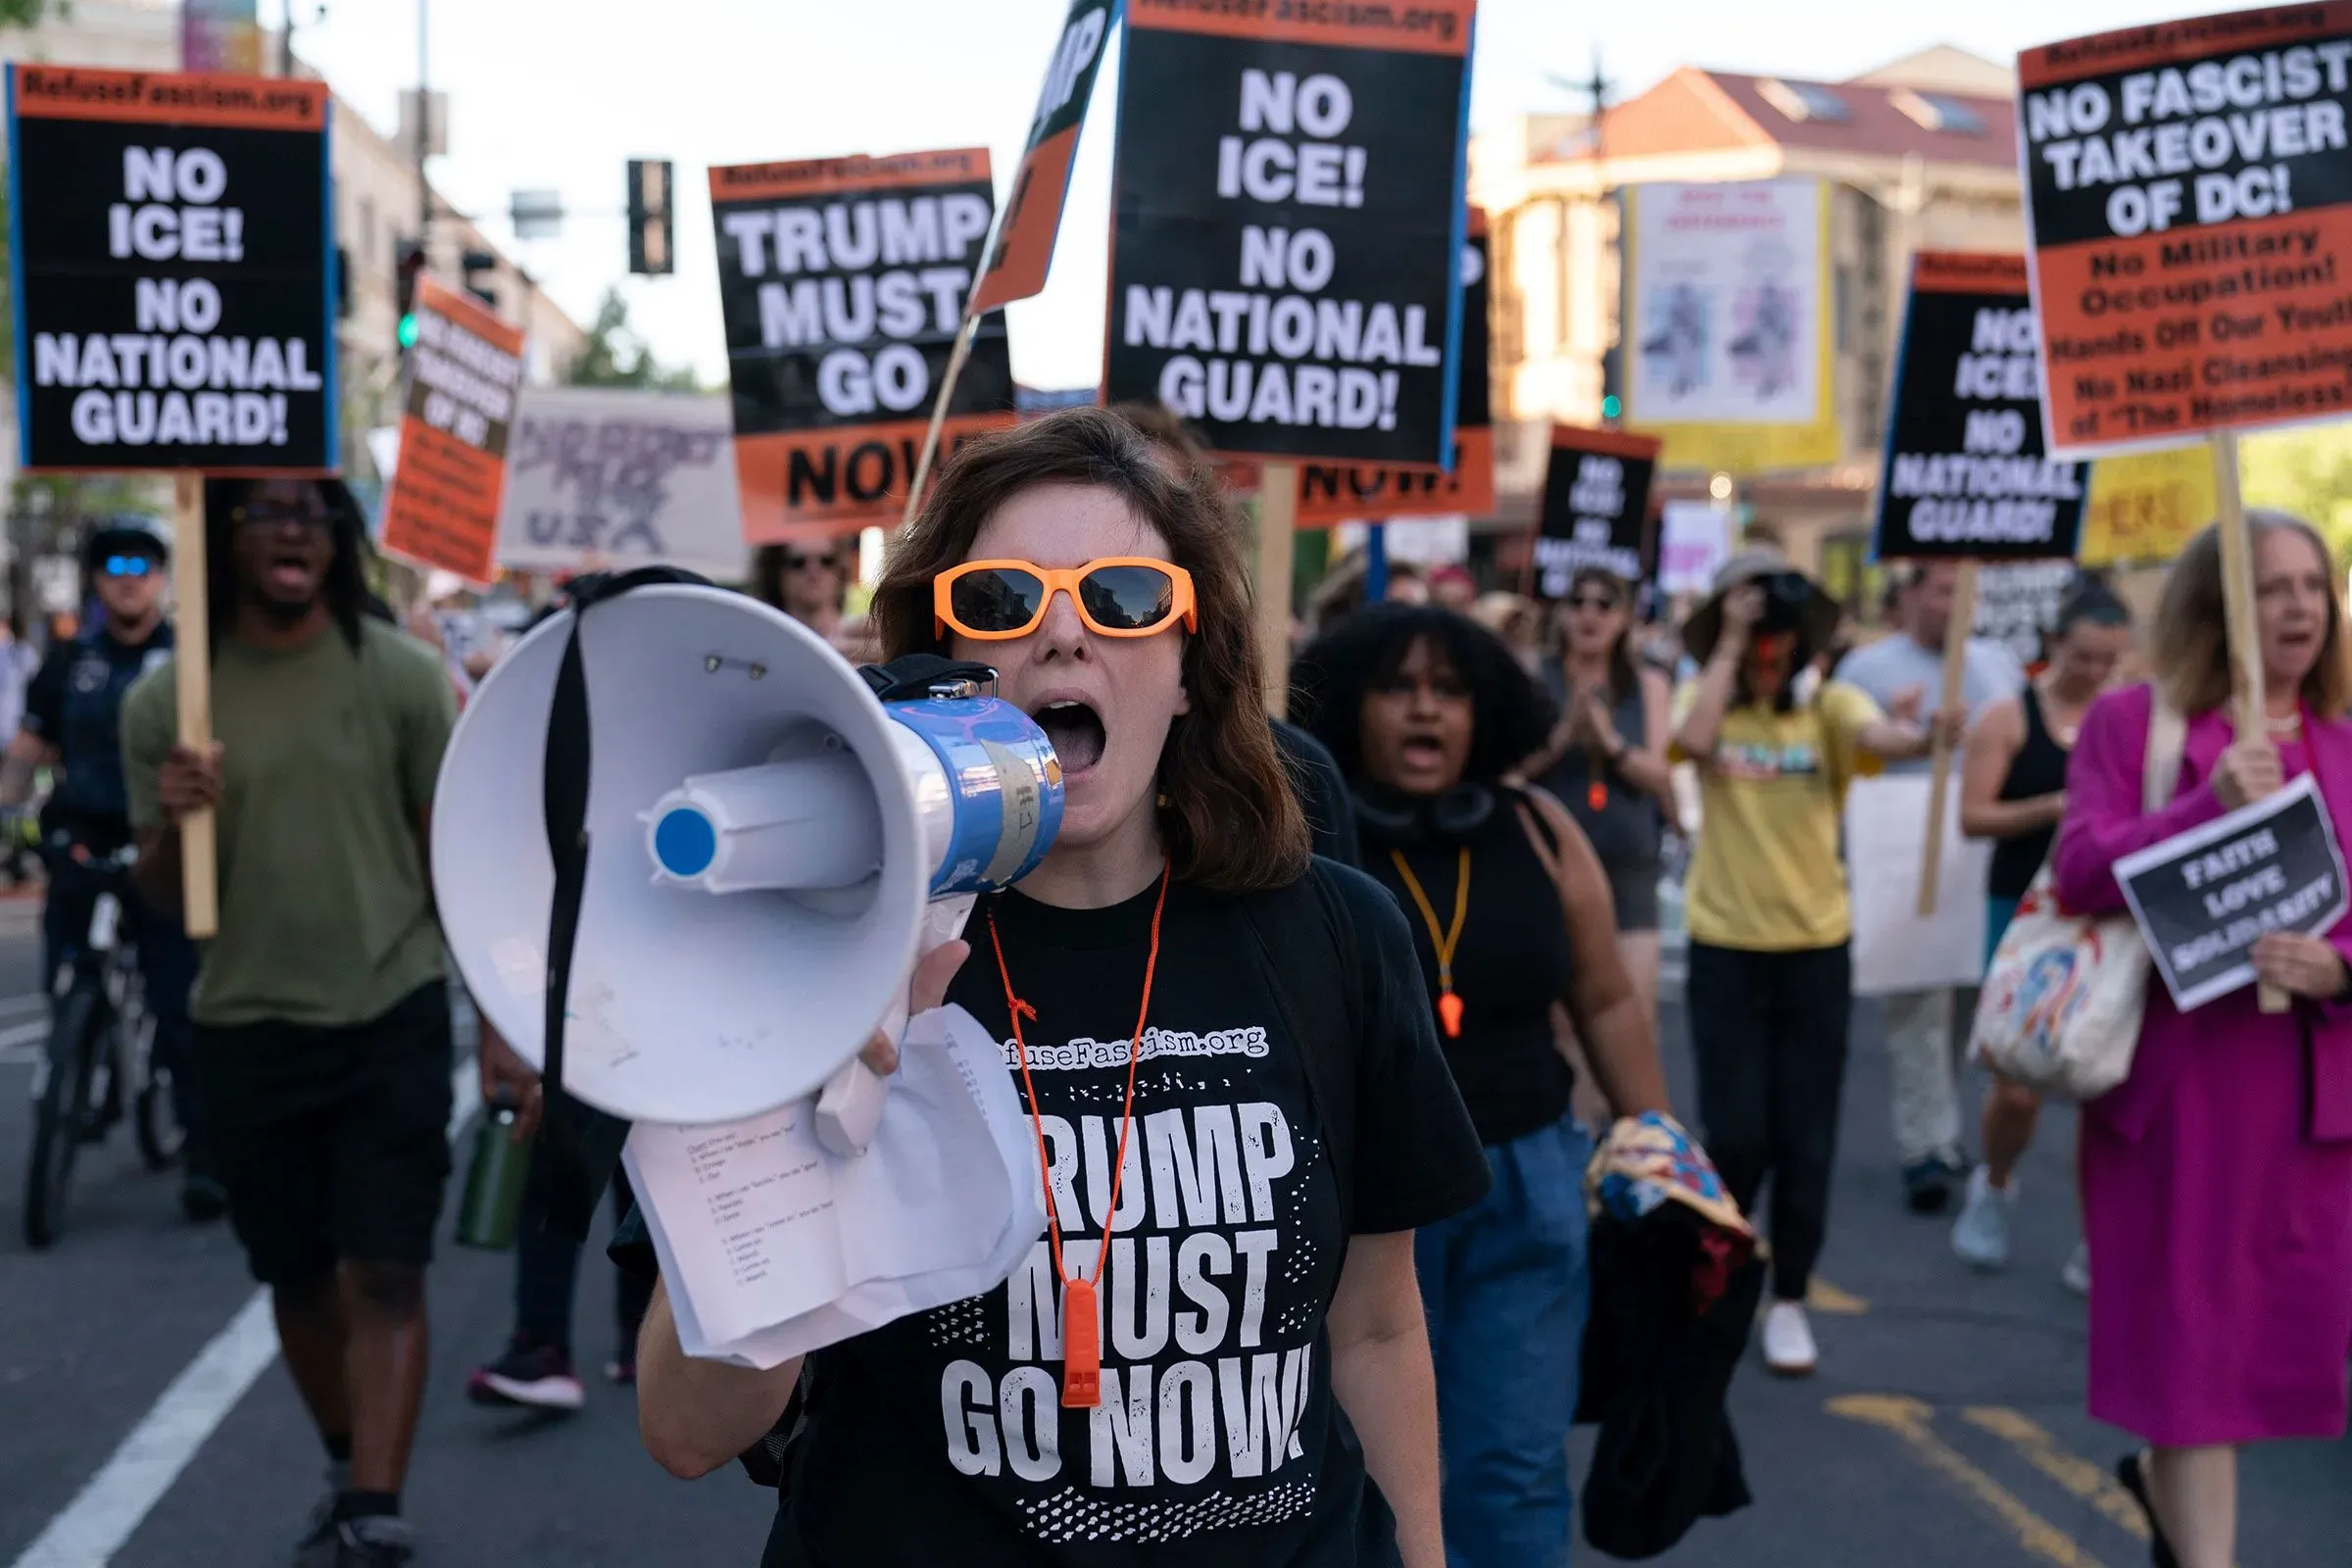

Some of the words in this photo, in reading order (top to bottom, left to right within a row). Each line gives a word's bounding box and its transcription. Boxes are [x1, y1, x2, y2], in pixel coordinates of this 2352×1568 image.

[1140, 0, 1458, 41] useFascism.org
[1239, 69, 1353, 138] NO
[2028, 83, 2111, 142] NO
[2121, 39, 2352, 123] FASCIST
[123, 145, 227, 204] NO
[1217, 136, 1367, 208] ICE!
[2042, 100, 2348, 189] TAKEOVER
[2106, 180, 2183, 237] OF
[2193, 164, 2293, 223] DC!
[109, 203, 244, 262] ICE!
[723, 193, 992, 276] TRUMP
[1239, 225, 1335, 292] NO
[2090, 253, 2145, 277] No
[2161, 228, 2319, 270] Military
[135, 277, 221, 332] NO
[758, 267, 971, 347] MUST
[2081, 256, 2336, 317] Occupation!
[1123, 284, 1441, 367] NATIONAL
[1971, 307, 2035, 353] NO
[2211, 312, 2264, 340] Our
[34, 331, 322, 390] NATIONAL
[815, 344, 930, 417] GO
[1953, 352, 2038, 400] ICE
[71, 390, 289, 446] GUARD!
[1159, 355, 1400, 431] GUARD!
[2189, 370, 2352, 421] Homeless
[1964, 411, 2027, 453] NO
[1891, 454, 2081, 500] NATIONAL
[1908, 501, 2056, 542] GUARD!
[2180, 828, 2279, 890] FAITH
[2203, 862, 2286, 919] LOVE
[1004, 1029, 1267, 1067] fuseFascism.org
[1022, 1102, 1295, 1233] RUMP
[1008, 1229, 1278, 1361] MUST
[941, 1359, 1062, 1482] GO
[1088, 1342, 1311, 1488] NOW!
